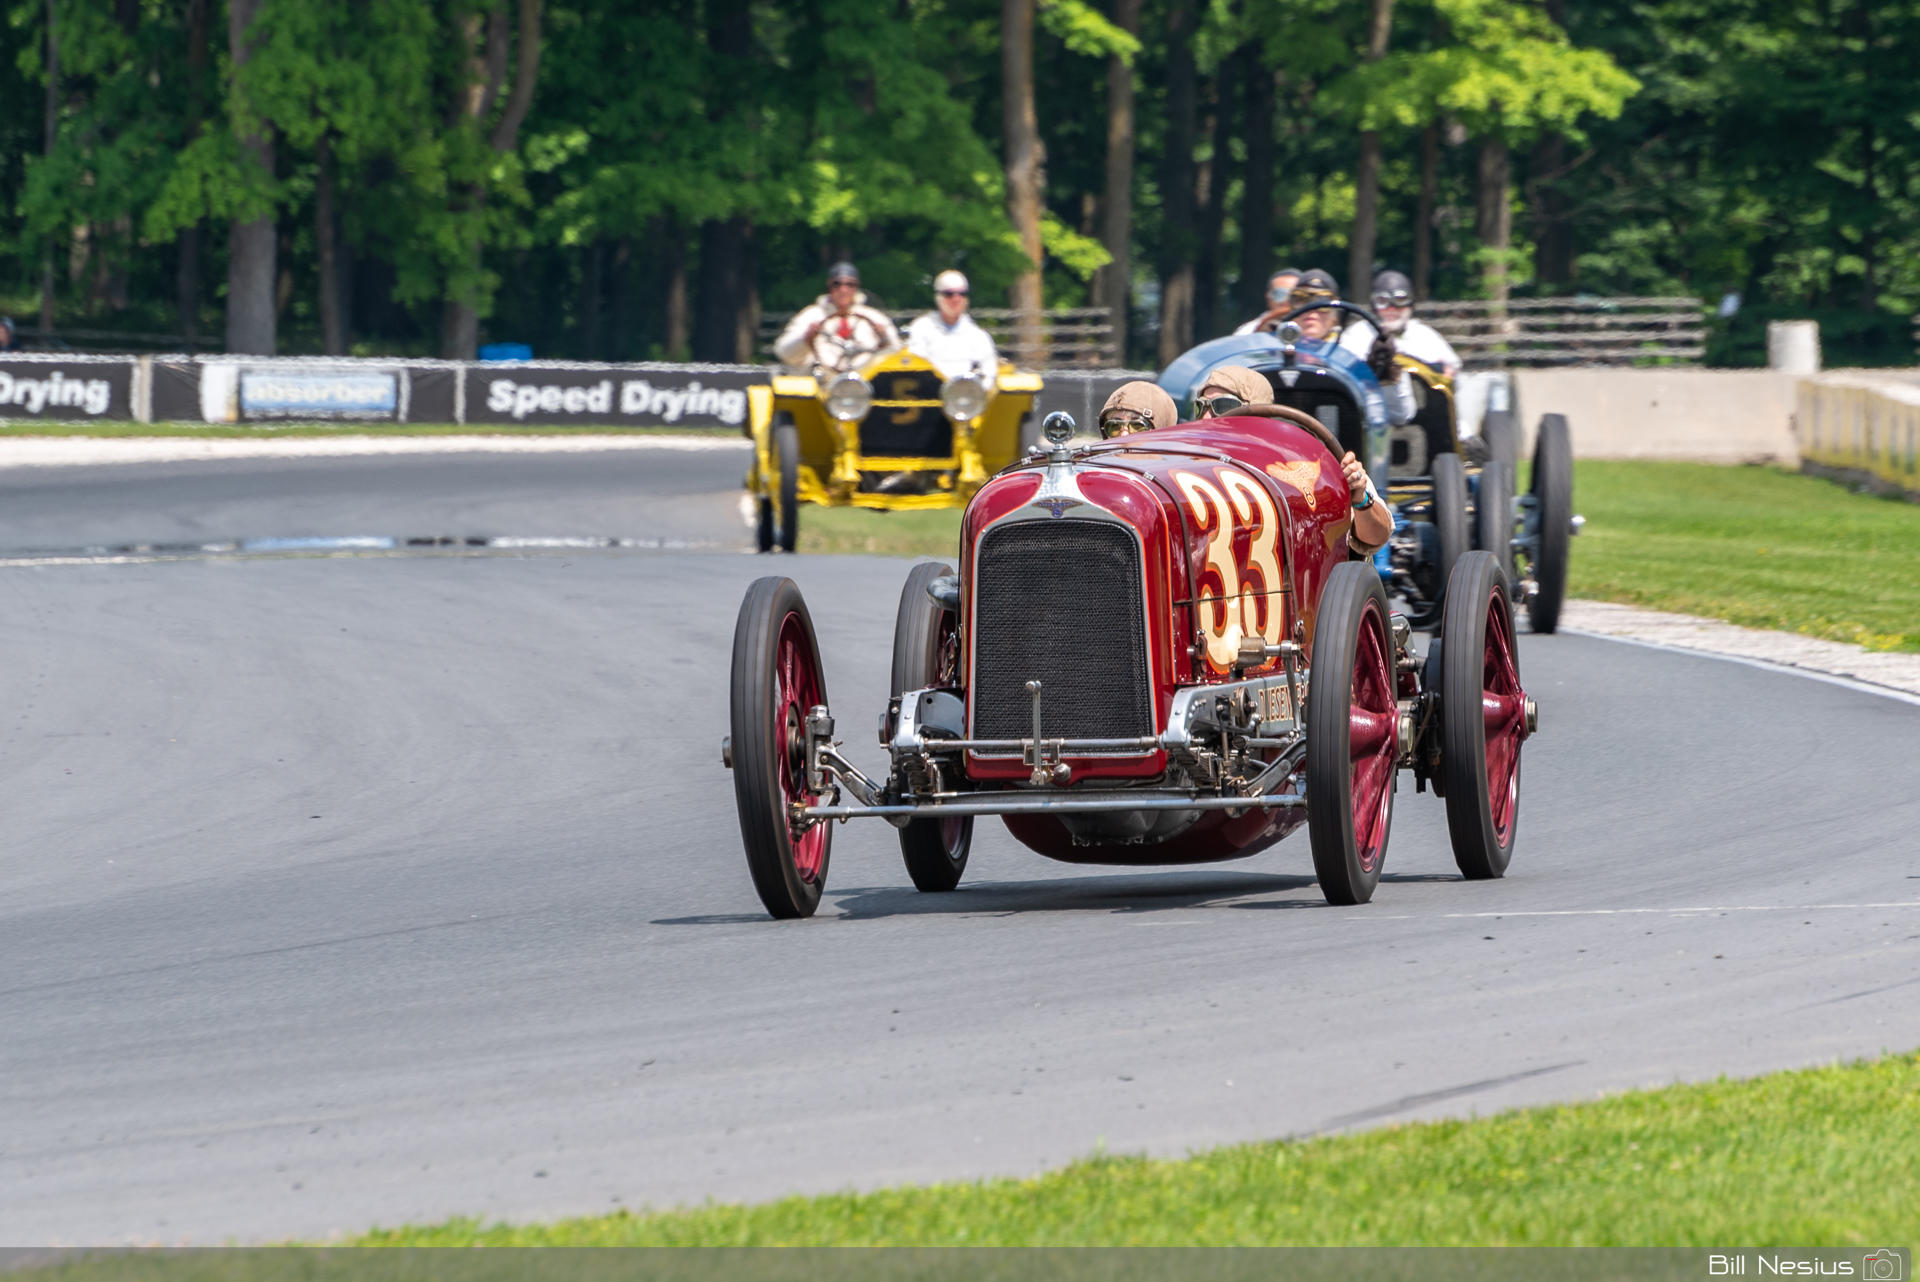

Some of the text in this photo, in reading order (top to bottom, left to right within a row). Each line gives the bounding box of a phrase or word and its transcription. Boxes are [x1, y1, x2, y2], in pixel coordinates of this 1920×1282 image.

[487, 379, 747, 425] Speed Drying
[891, 378, 921, 425] 5
[1169, 467, 1285, 675] 33
